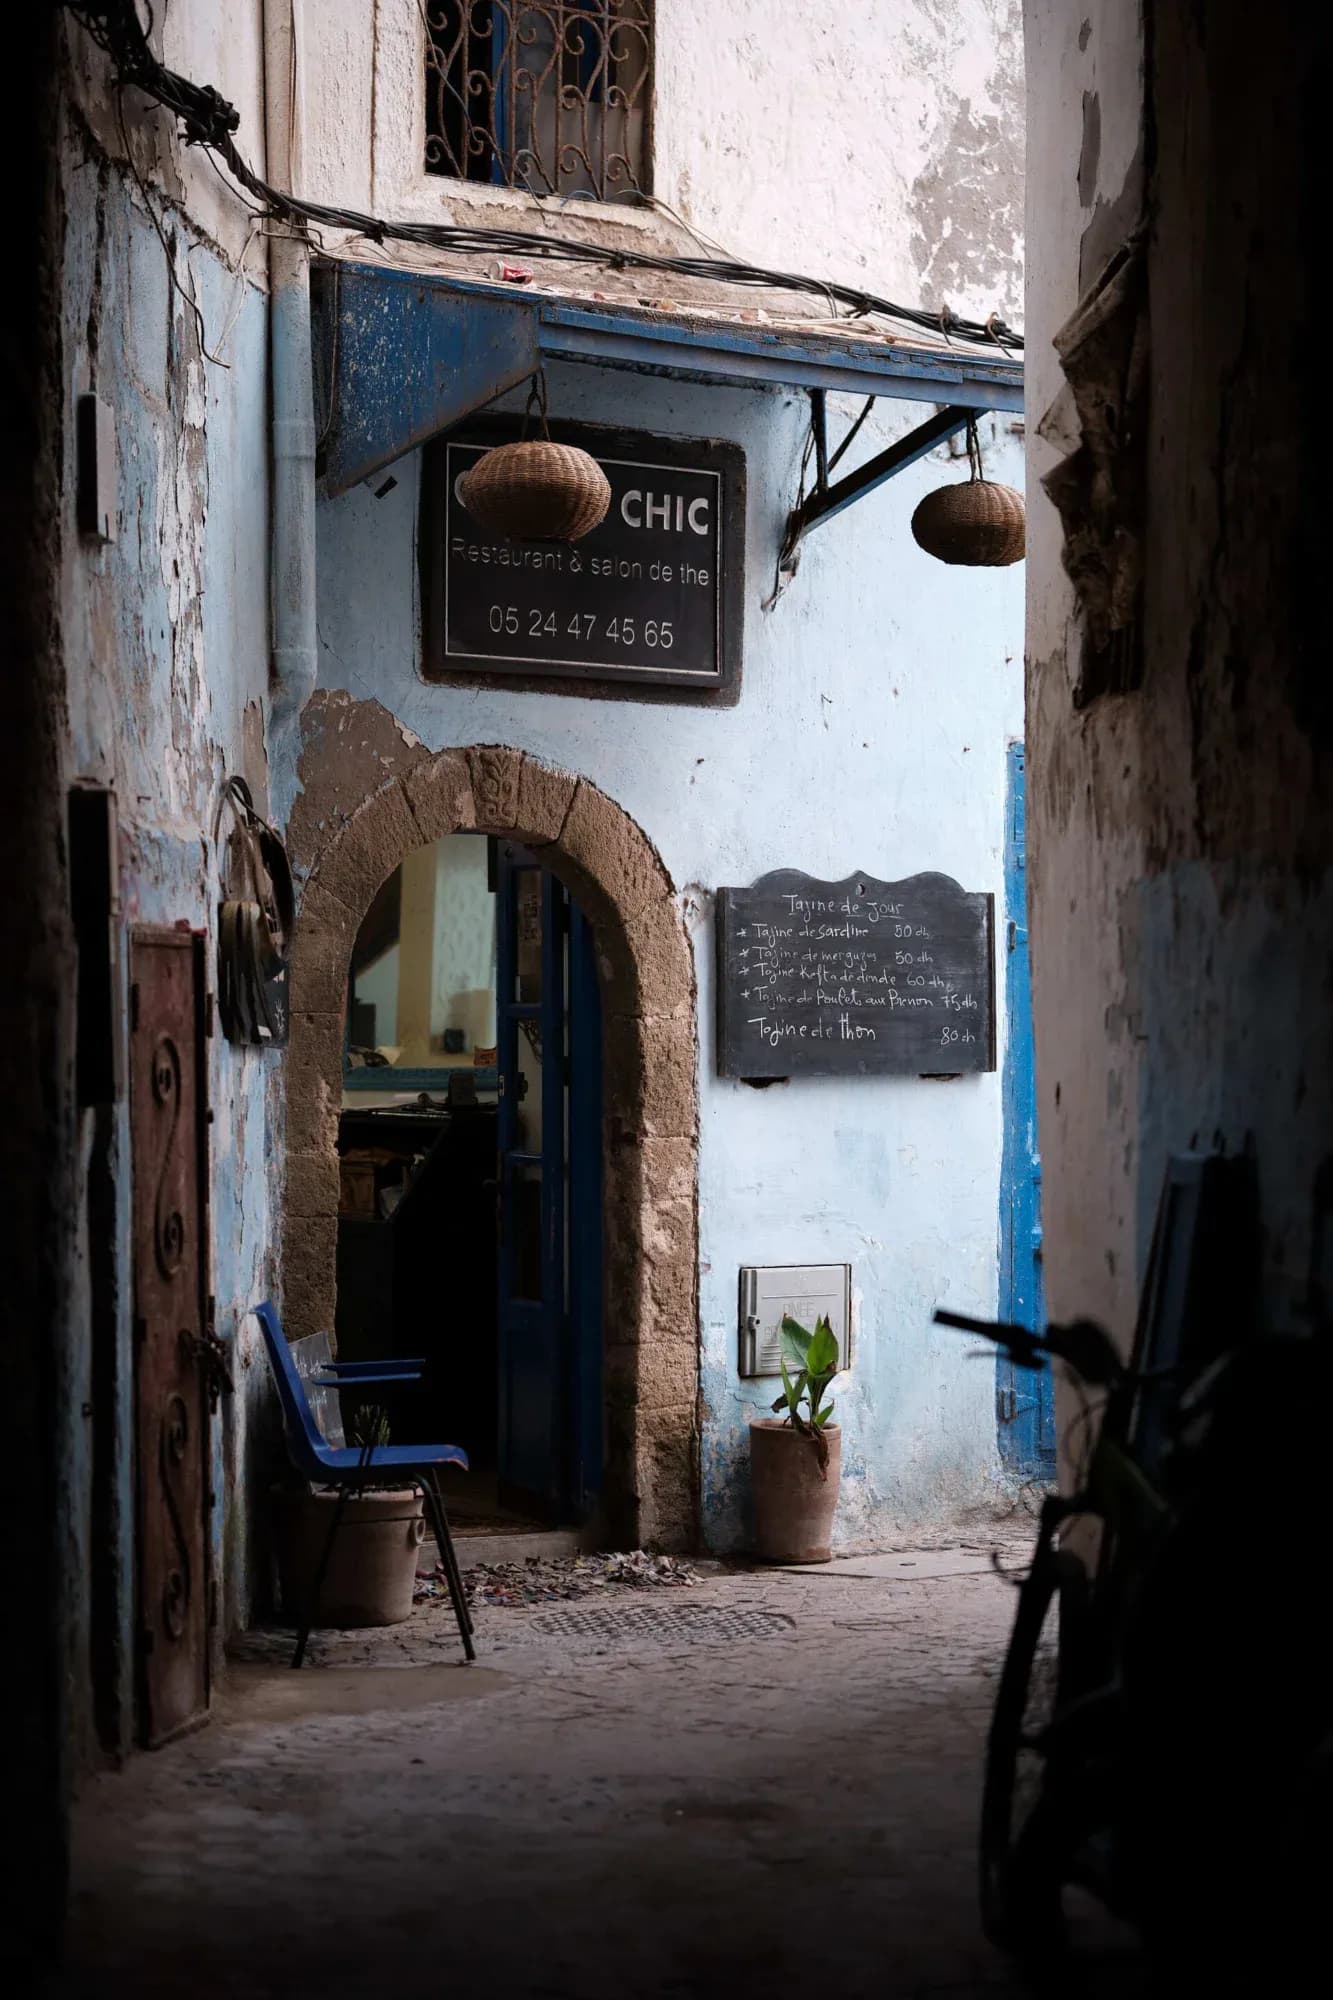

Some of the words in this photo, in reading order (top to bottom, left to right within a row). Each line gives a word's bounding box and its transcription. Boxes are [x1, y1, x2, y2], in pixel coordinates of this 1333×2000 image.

[621, 489, 709, 535] CHIC
[452, 537, 562, 571] Restaurant
[569, 549, 583, 573] &
[591, 557, 642, 579] salon
[650, 560, 673, 582] de
[680, 562, 709, 586] the
[489, 605, 519, 634] 05
[528, 609, 557, 637] 24
[567, 613, 597, 641] 47
[606, 617, 635, 645] 45
[644, 620, 673, 648] 65
[781, 894, 835, 923] Tajine
[840, 896, 860, 915] de
[751, 923, 793, 948] Tajine
[799, 923, 816, 937] de
[894, 924, 912, 938] 50
[751, 946, 799, 969] Tajine
[801, 947, 818, 962] de
[895, 951, 914, 965] 50
[916, 951, 934, 963] dh
[752, 962, 794, 984] Tajine
[906, 972, 925, 986] 60
[940, 994, 961, 1012] 75
[747, 1016, 807, 1047] Tajine
[811, 1017, 833, 1039] de
[940, 1026, 959, 1045] 80
